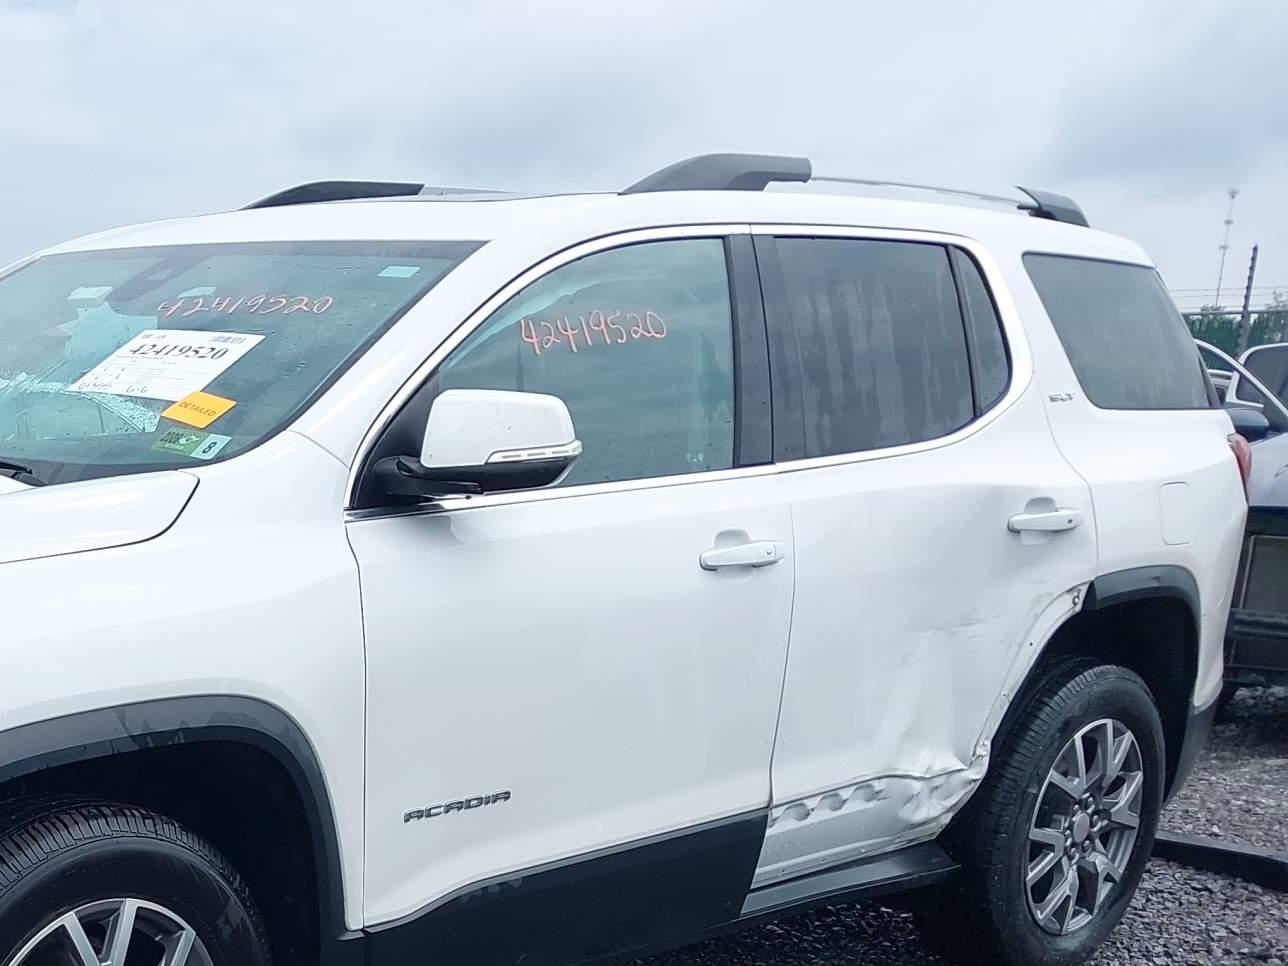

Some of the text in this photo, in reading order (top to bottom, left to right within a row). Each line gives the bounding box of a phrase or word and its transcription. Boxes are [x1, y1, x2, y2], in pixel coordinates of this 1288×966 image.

[158, 294, 333, 317] 42419520
[520, 310, 667, 355] 42419520
[129, 343, 230, 360] 42419520
[178, 401, 217, 417] DETAILED
[201, 441, 218, 454] 8
[403, 790, 511, 823] ACADIA
